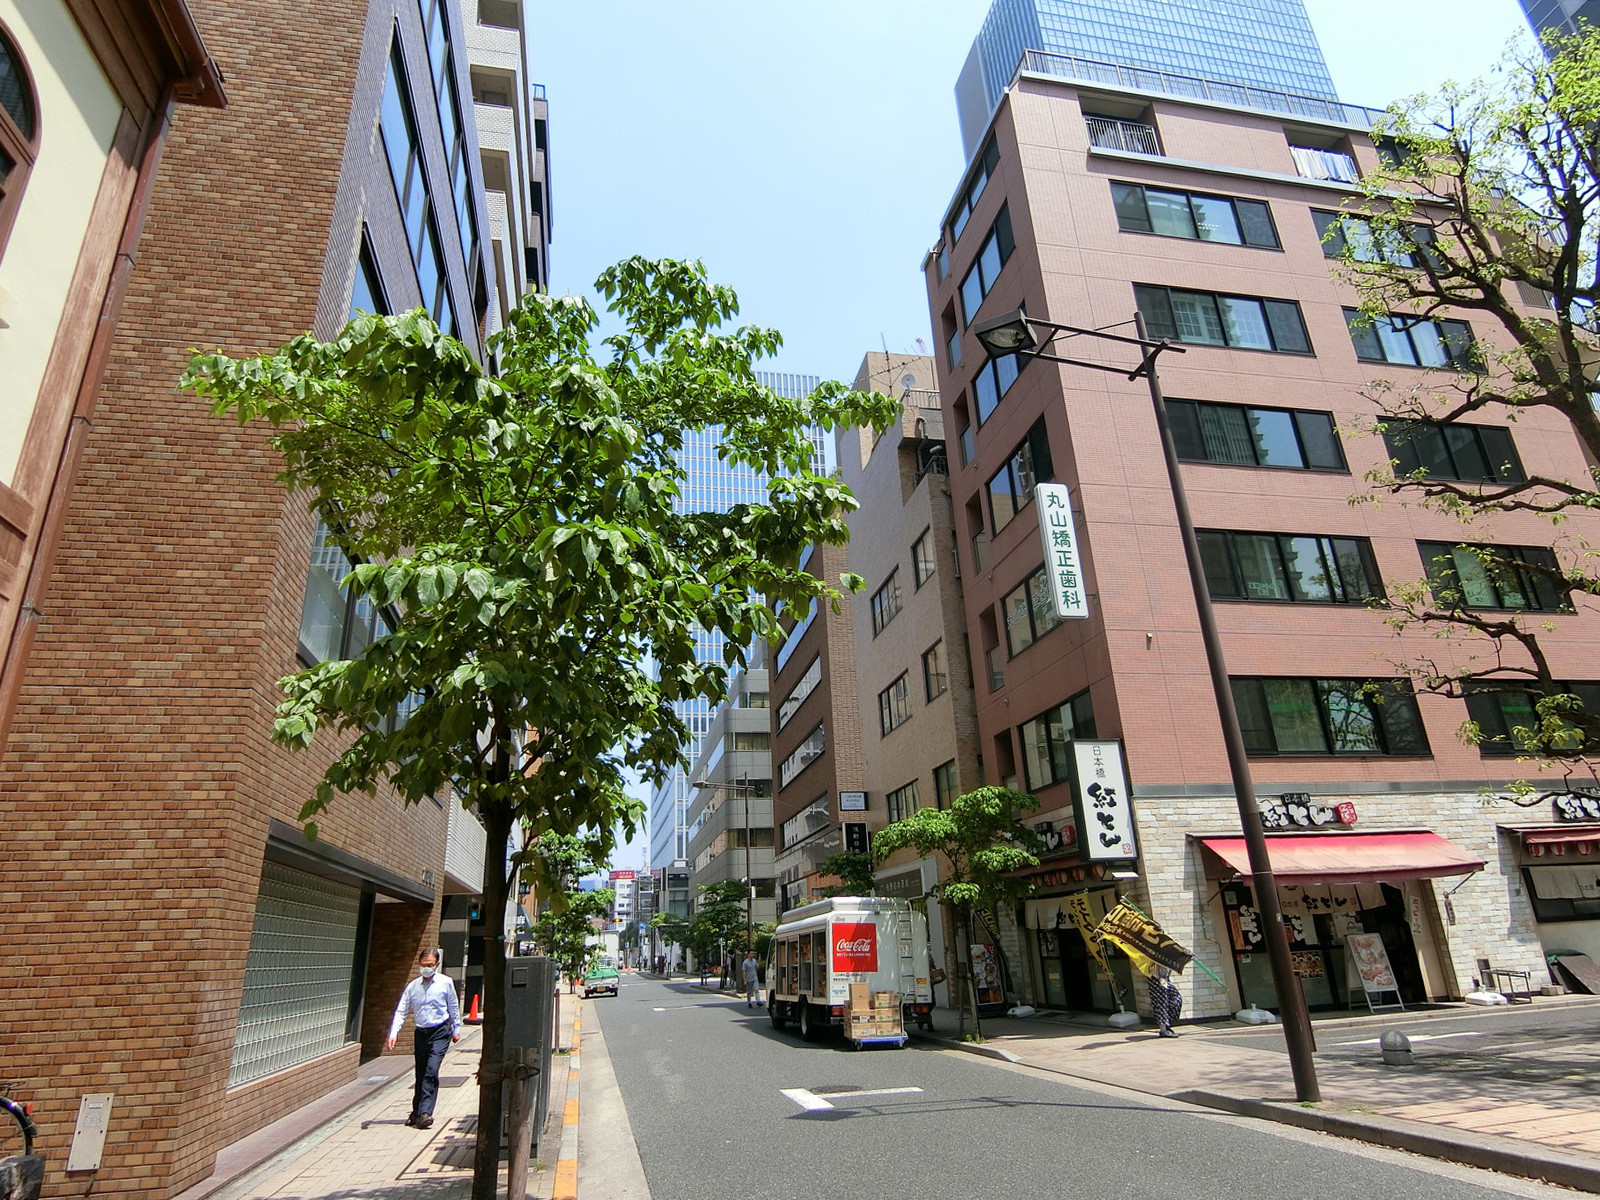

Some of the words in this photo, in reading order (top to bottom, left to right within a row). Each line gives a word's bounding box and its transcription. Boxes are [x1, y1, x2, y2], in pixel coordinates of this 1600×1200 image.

[1046, 491, 1081, 609] 丸山矯正歯科
[1093, 746, 1106, 778] 日本橋
[1087, 782, 1121, 848] 紅とん
